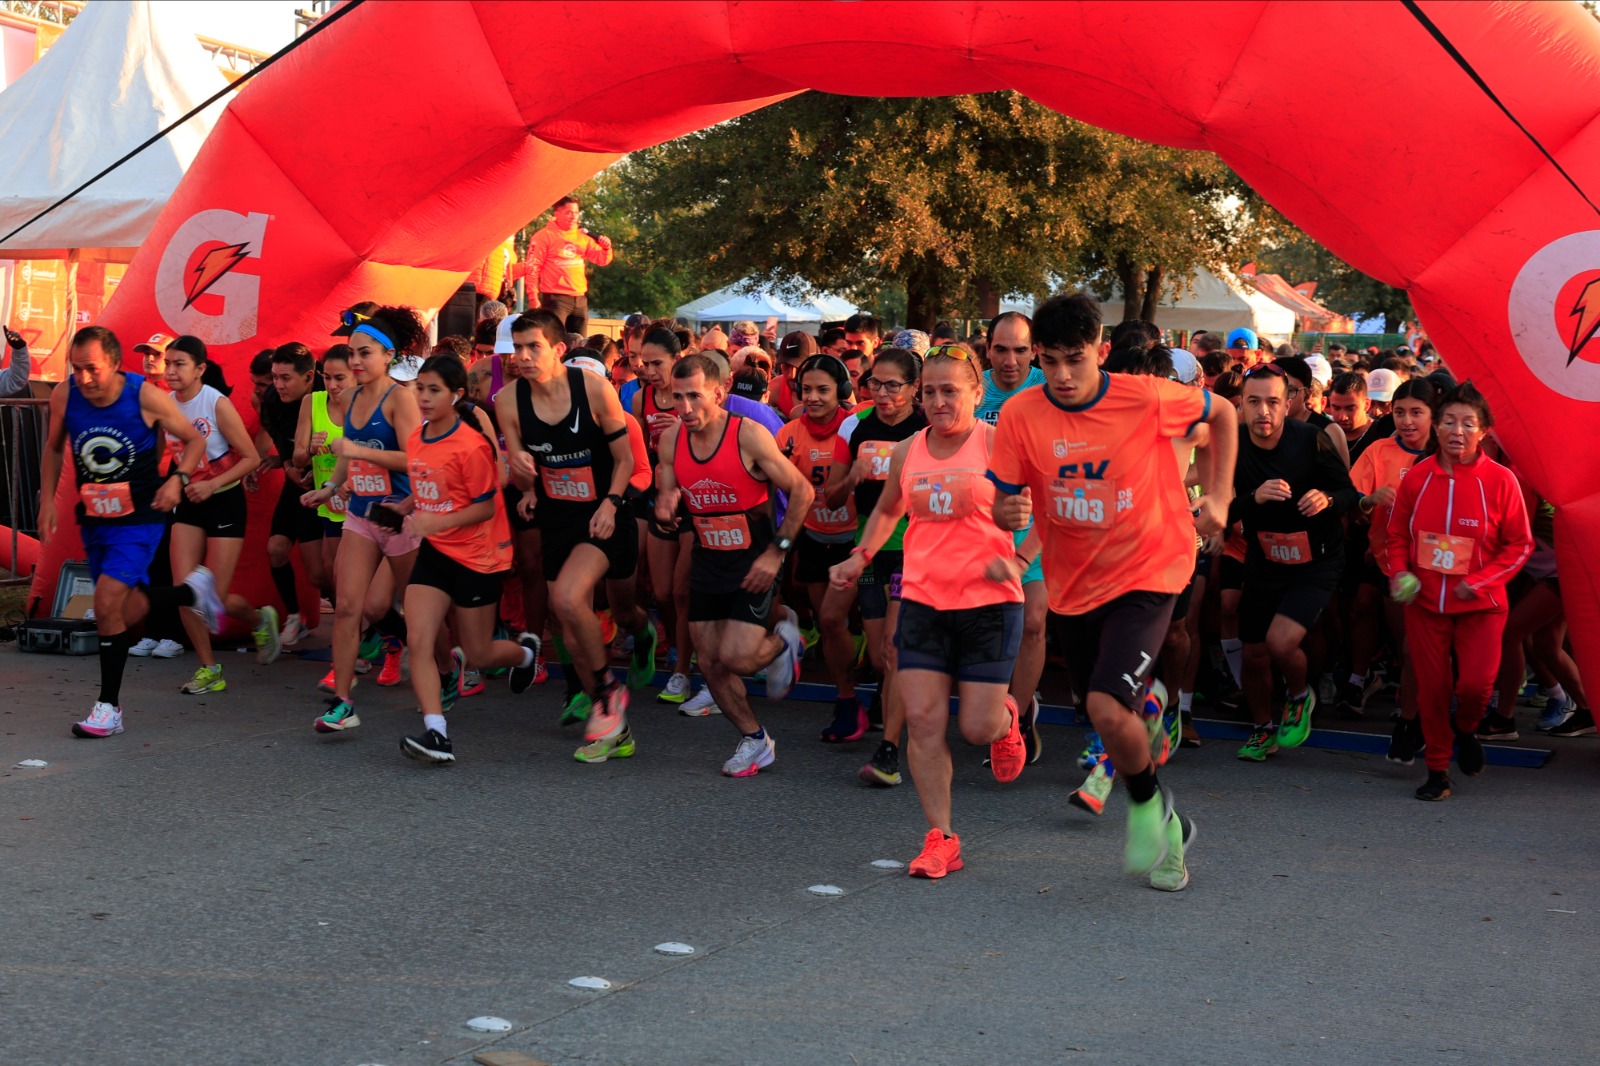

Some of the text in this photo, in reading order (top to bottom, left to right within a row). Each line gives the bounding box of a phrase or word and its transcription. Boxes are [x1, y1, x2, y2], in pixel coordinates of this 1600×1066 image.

[155, 208, 269, 345] G
[736, 382, 753, 391] RUN
[351, 474, 386, 492] 1565
[547, 480, 589, 498] 1569
[91, 497, 122, 514] 314
[928, 491, 954, 515] 42
[1053, 496, 1104, 523] 1703
[813, 505, 849, 522] 1123
[1458, 518, 1479, 527] GYM
[702, 528, 744, 547] 1739
[1270, 544, 1301, 561] 404
[1431, 548, 1455, 570] 28
